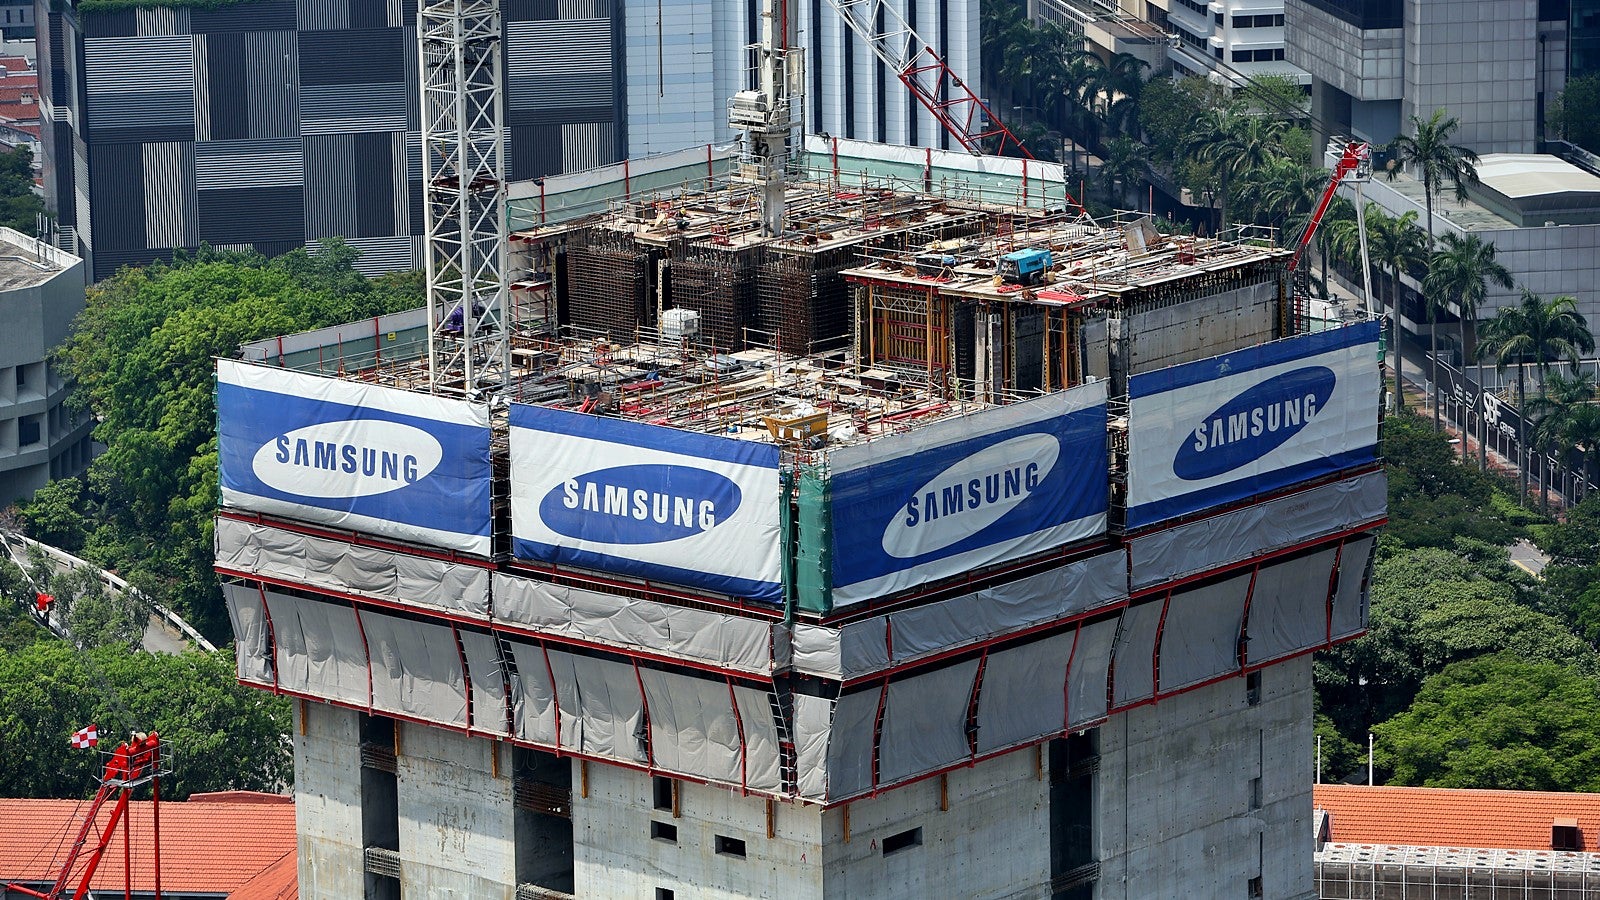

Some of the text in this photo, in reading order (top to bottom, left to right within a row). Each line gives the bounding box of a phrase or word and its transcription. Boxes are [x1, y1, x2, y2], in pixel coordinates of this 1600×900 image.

[1194, 393, 1316, 452] SAMSUNG
[1483, 392, 1502, 426] SBF
[275, 434, 418, 484] SAMSUNG
[563, 477, 715, 532] SAMSUNG
[905, 462, 1039, 527] SAMSUNG
